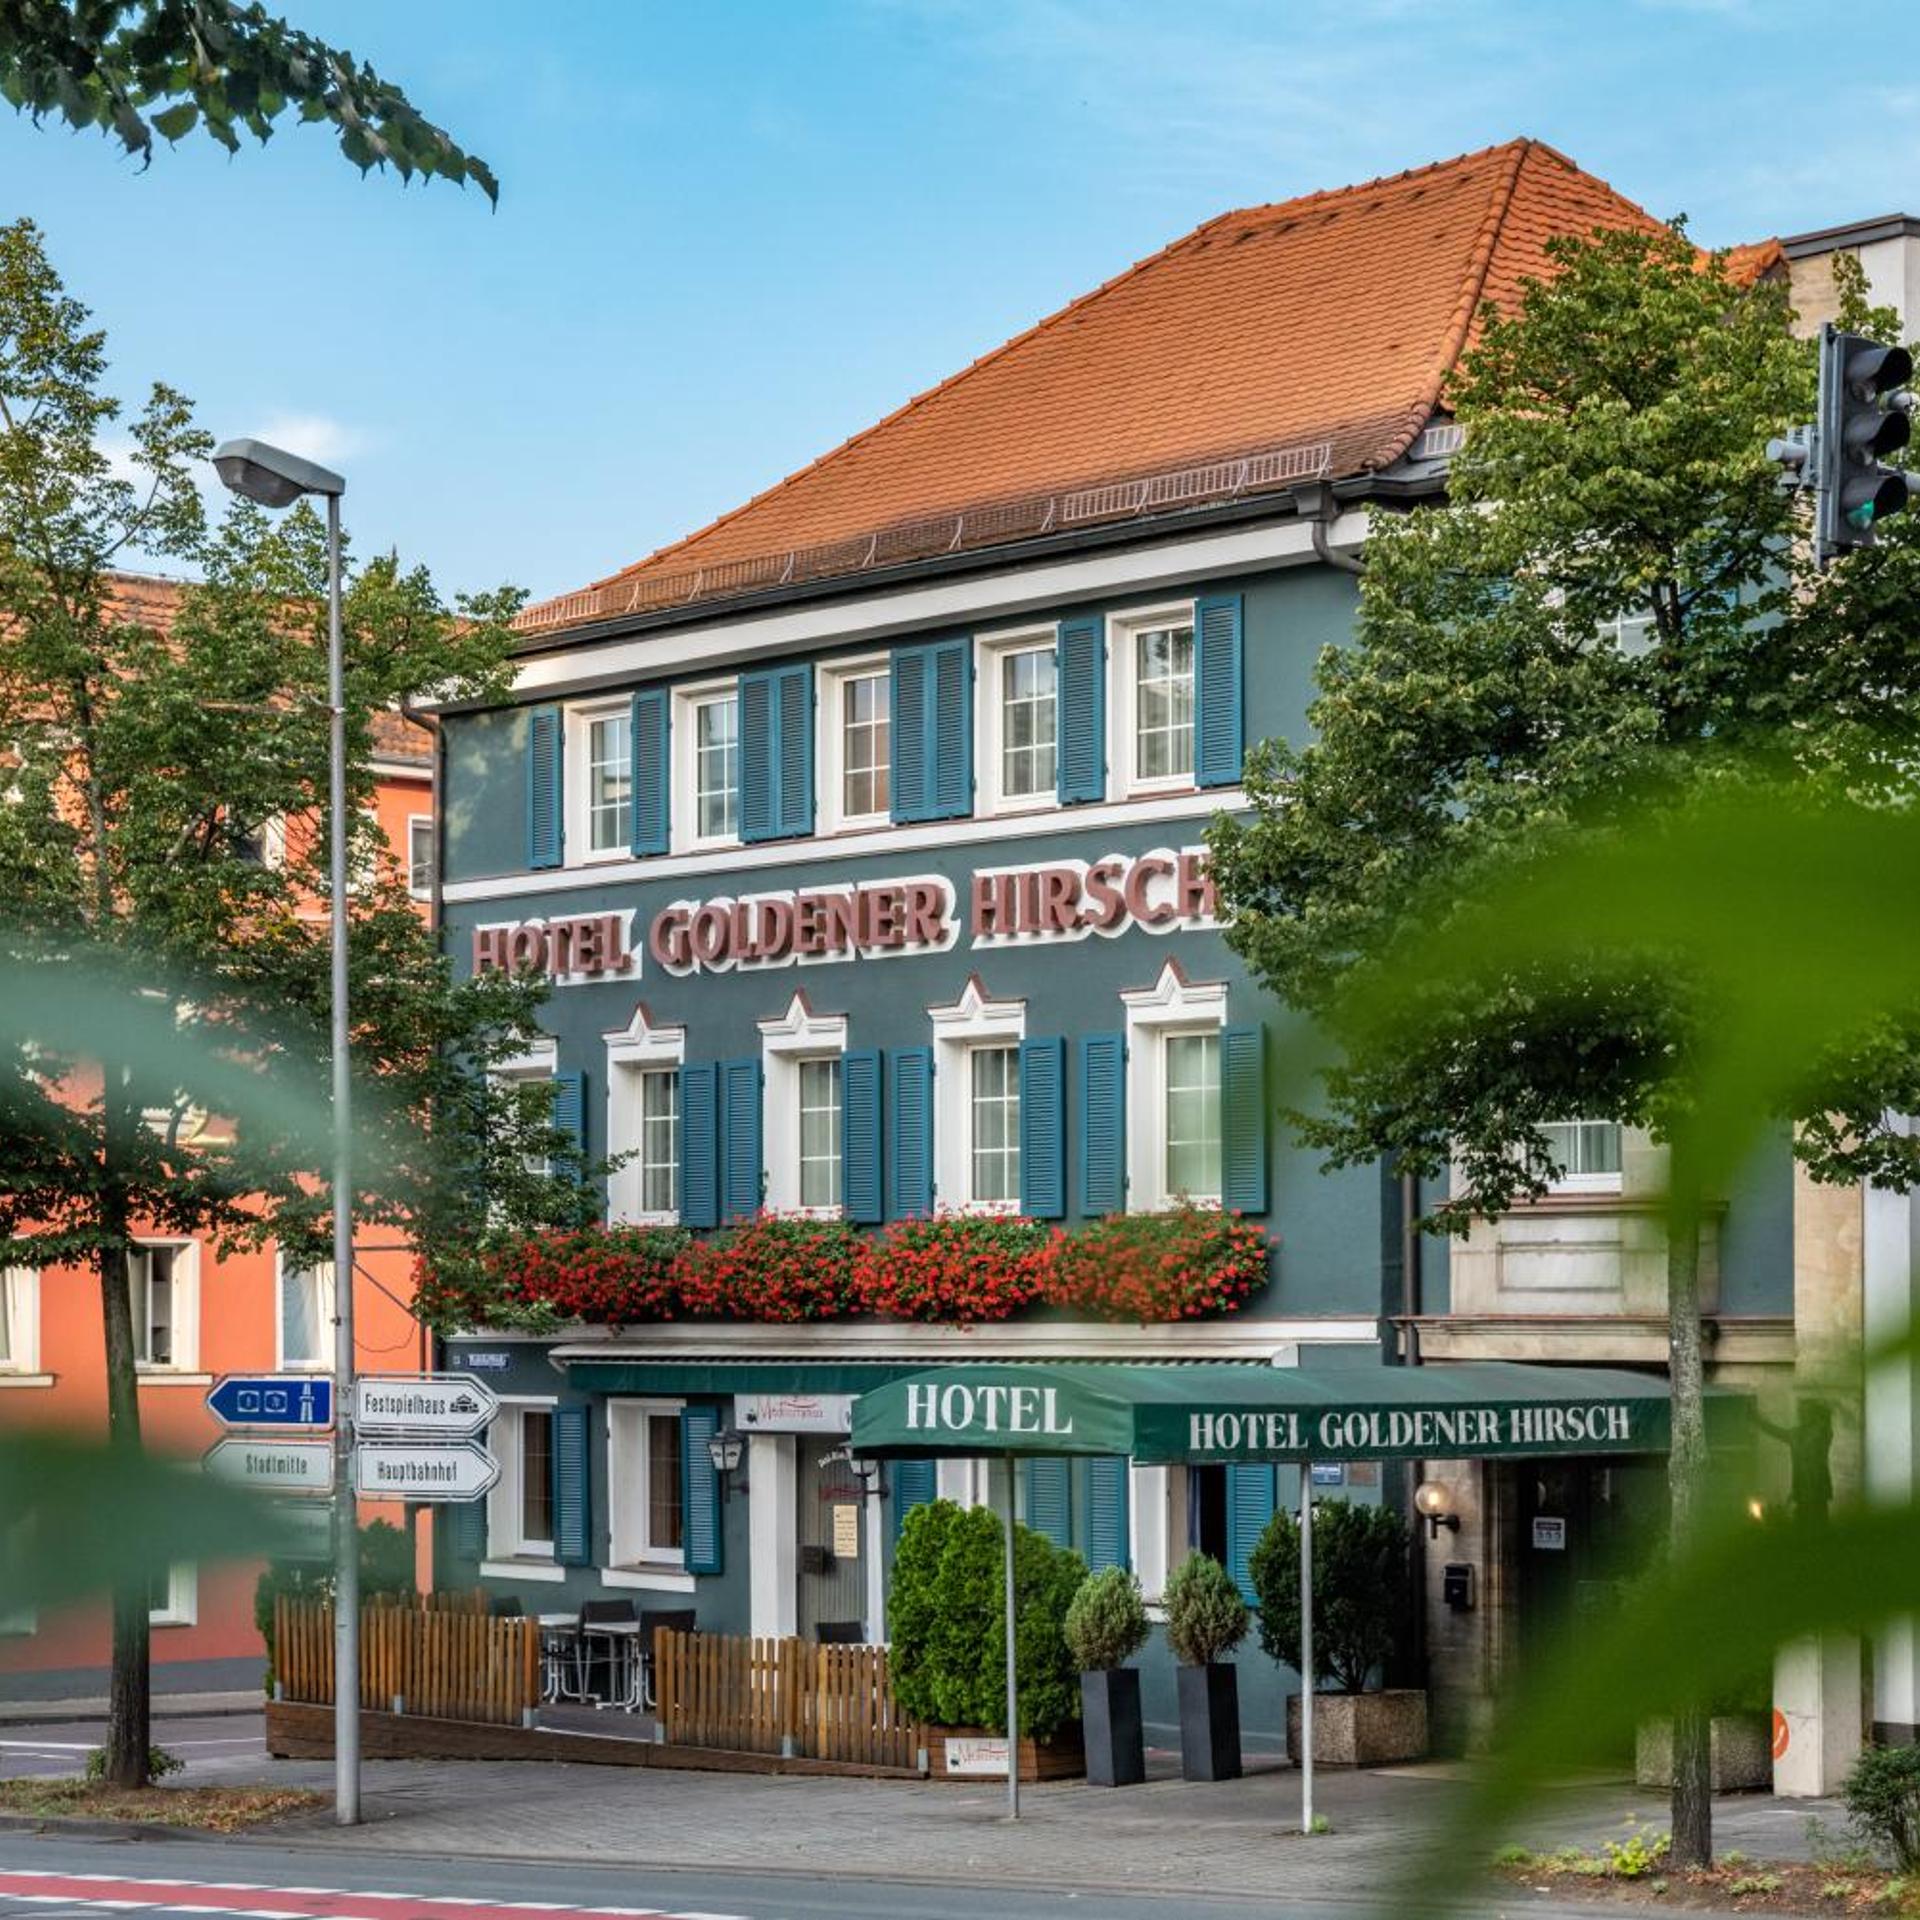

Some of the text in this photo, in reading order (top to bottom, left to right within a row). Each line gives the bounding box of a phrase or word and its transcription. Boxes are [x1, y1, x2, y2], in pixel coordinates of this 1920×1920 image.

[471, 851, 1220, 978] HOTEL GOLDENER HIRSCH
[365, 1393, 446, 1416] Festspielhaus
[906, 1384, 1073, 1434] HOTEL
[1189, 1405, 1630, 1450] HOTEL GOLDENER HIRSCH
[246, 1453, 308, 1475] Stadtmitte
[377, 1460, 458, 1483] Hauptbahnhof
